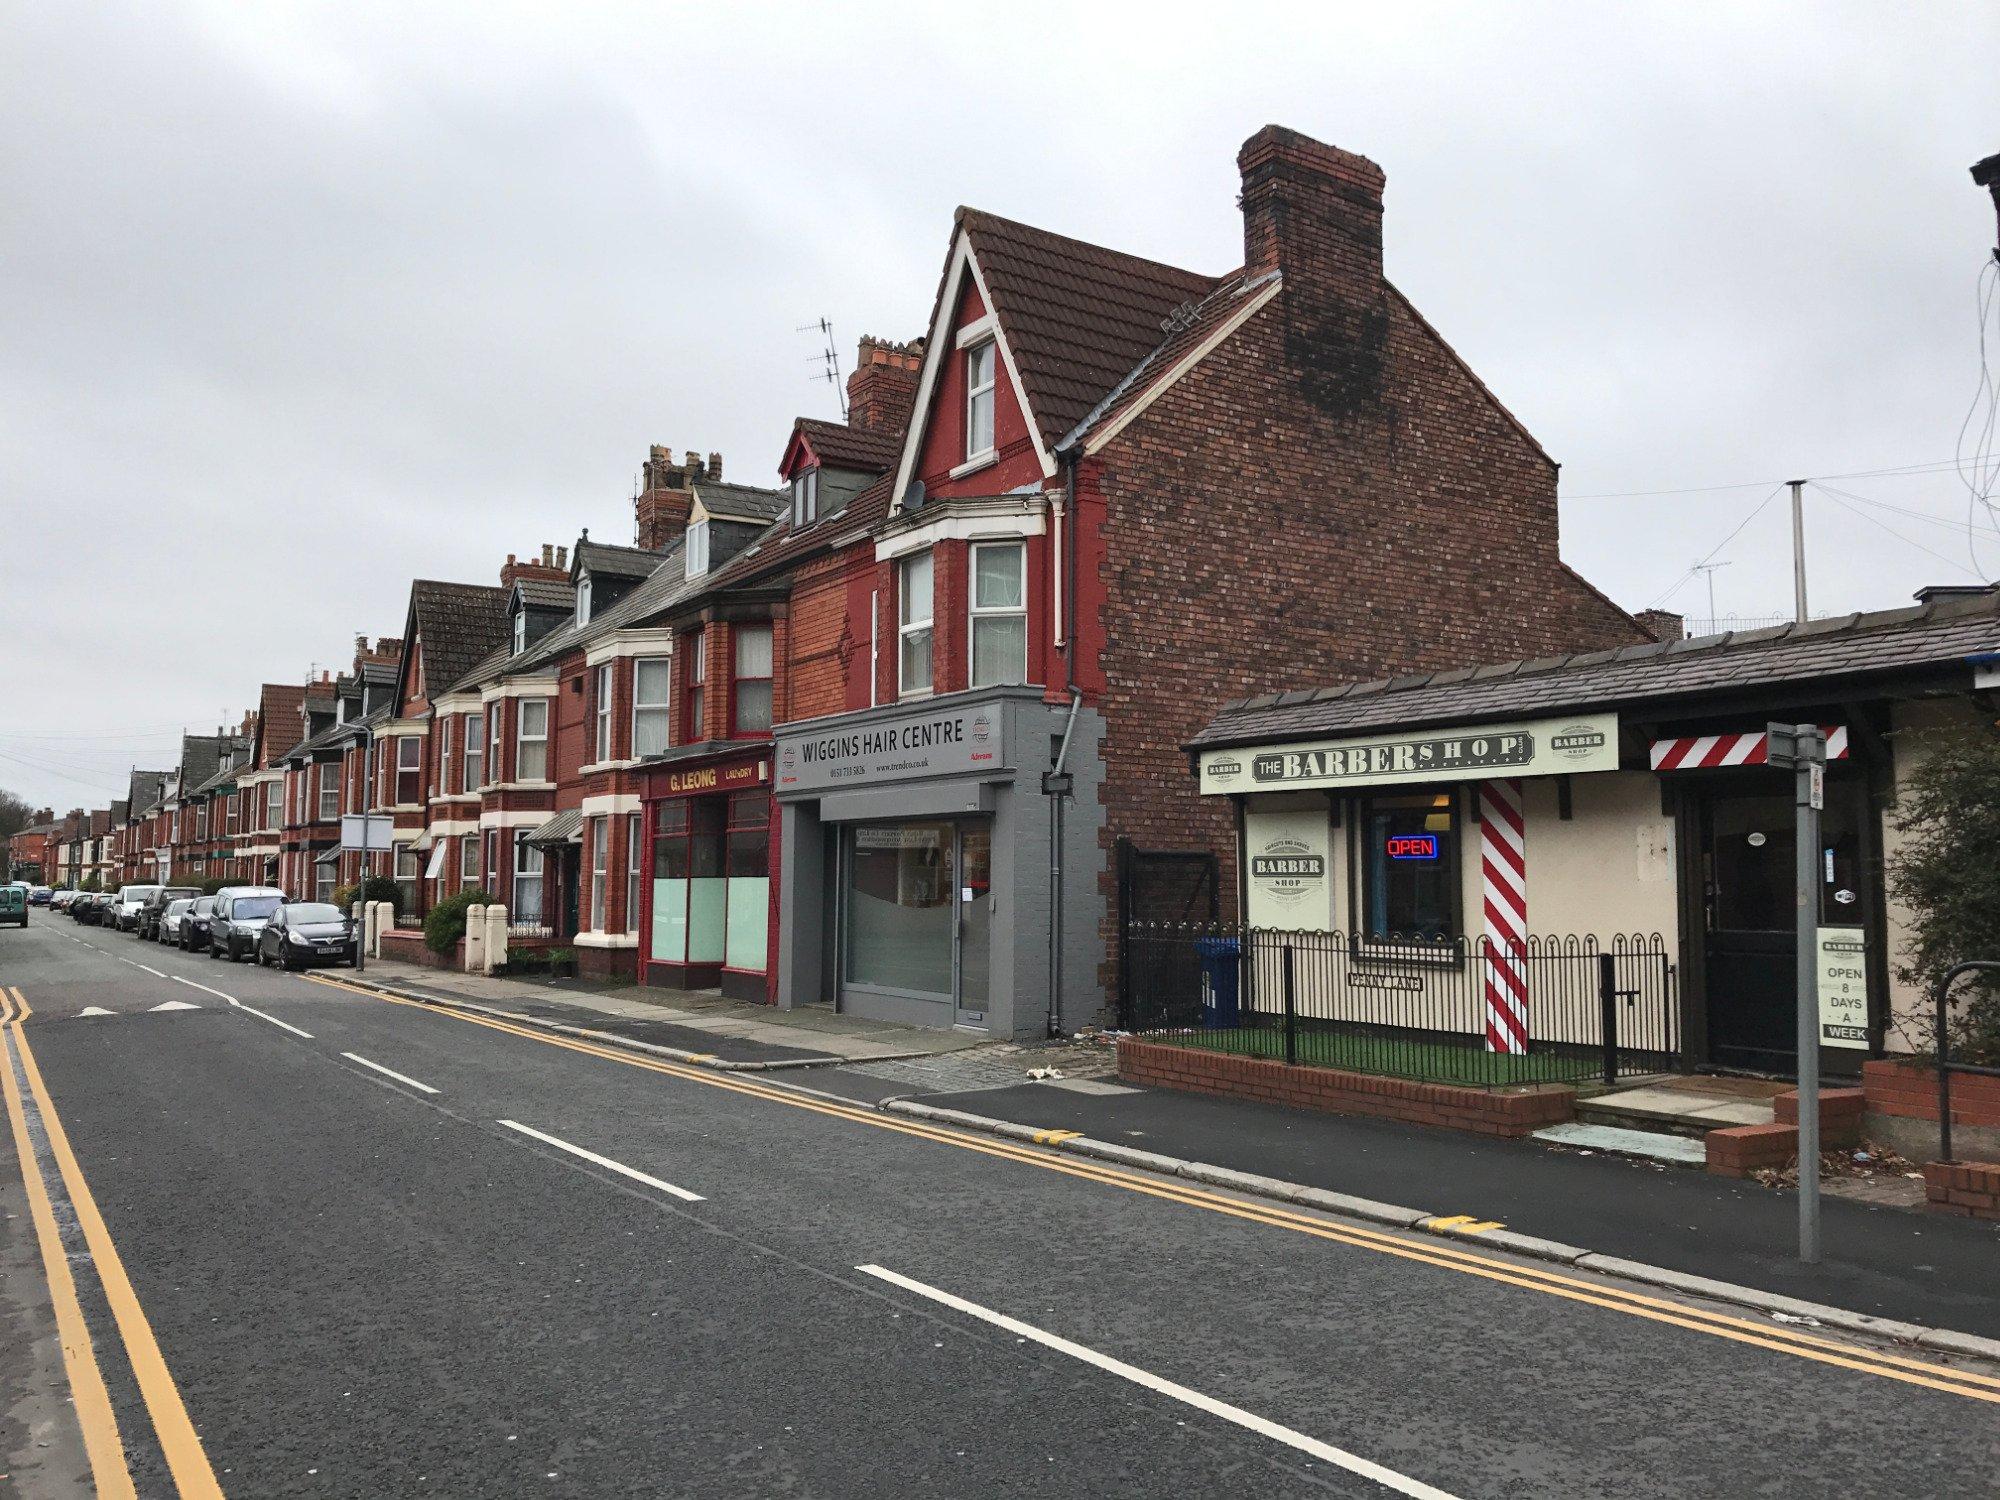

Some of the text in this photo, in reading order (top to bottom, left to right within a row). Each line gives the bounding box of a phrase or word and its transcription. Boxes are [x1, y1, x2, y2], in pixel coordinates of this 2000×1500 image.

[802, 719, 963, 763] WIGGINS HAIR CENTRE
[1554, 735, 1602, 748] BARBER
[725, 766, 753, 780] LAUNDRY
[1259, 761, 1281, 775] THE
[670, 768, 717, 791] G. LEONG
[1387, 840, 1433, 855] OPEN
[1256, 860, 1320, 873] BARBER
[1274, 879, 1301, 887] SHOP
[1827, 968, 1862, 979] OPEN
[1351, 973, 1420, 990] PENNY LANE
[1842, 982, 1849, 993] 8
[1830, 997, 1862, 1009] DAYS
[1842, 1012, 1851, 1023] A
[1829, 1026, 1867, 1040] WEEK
